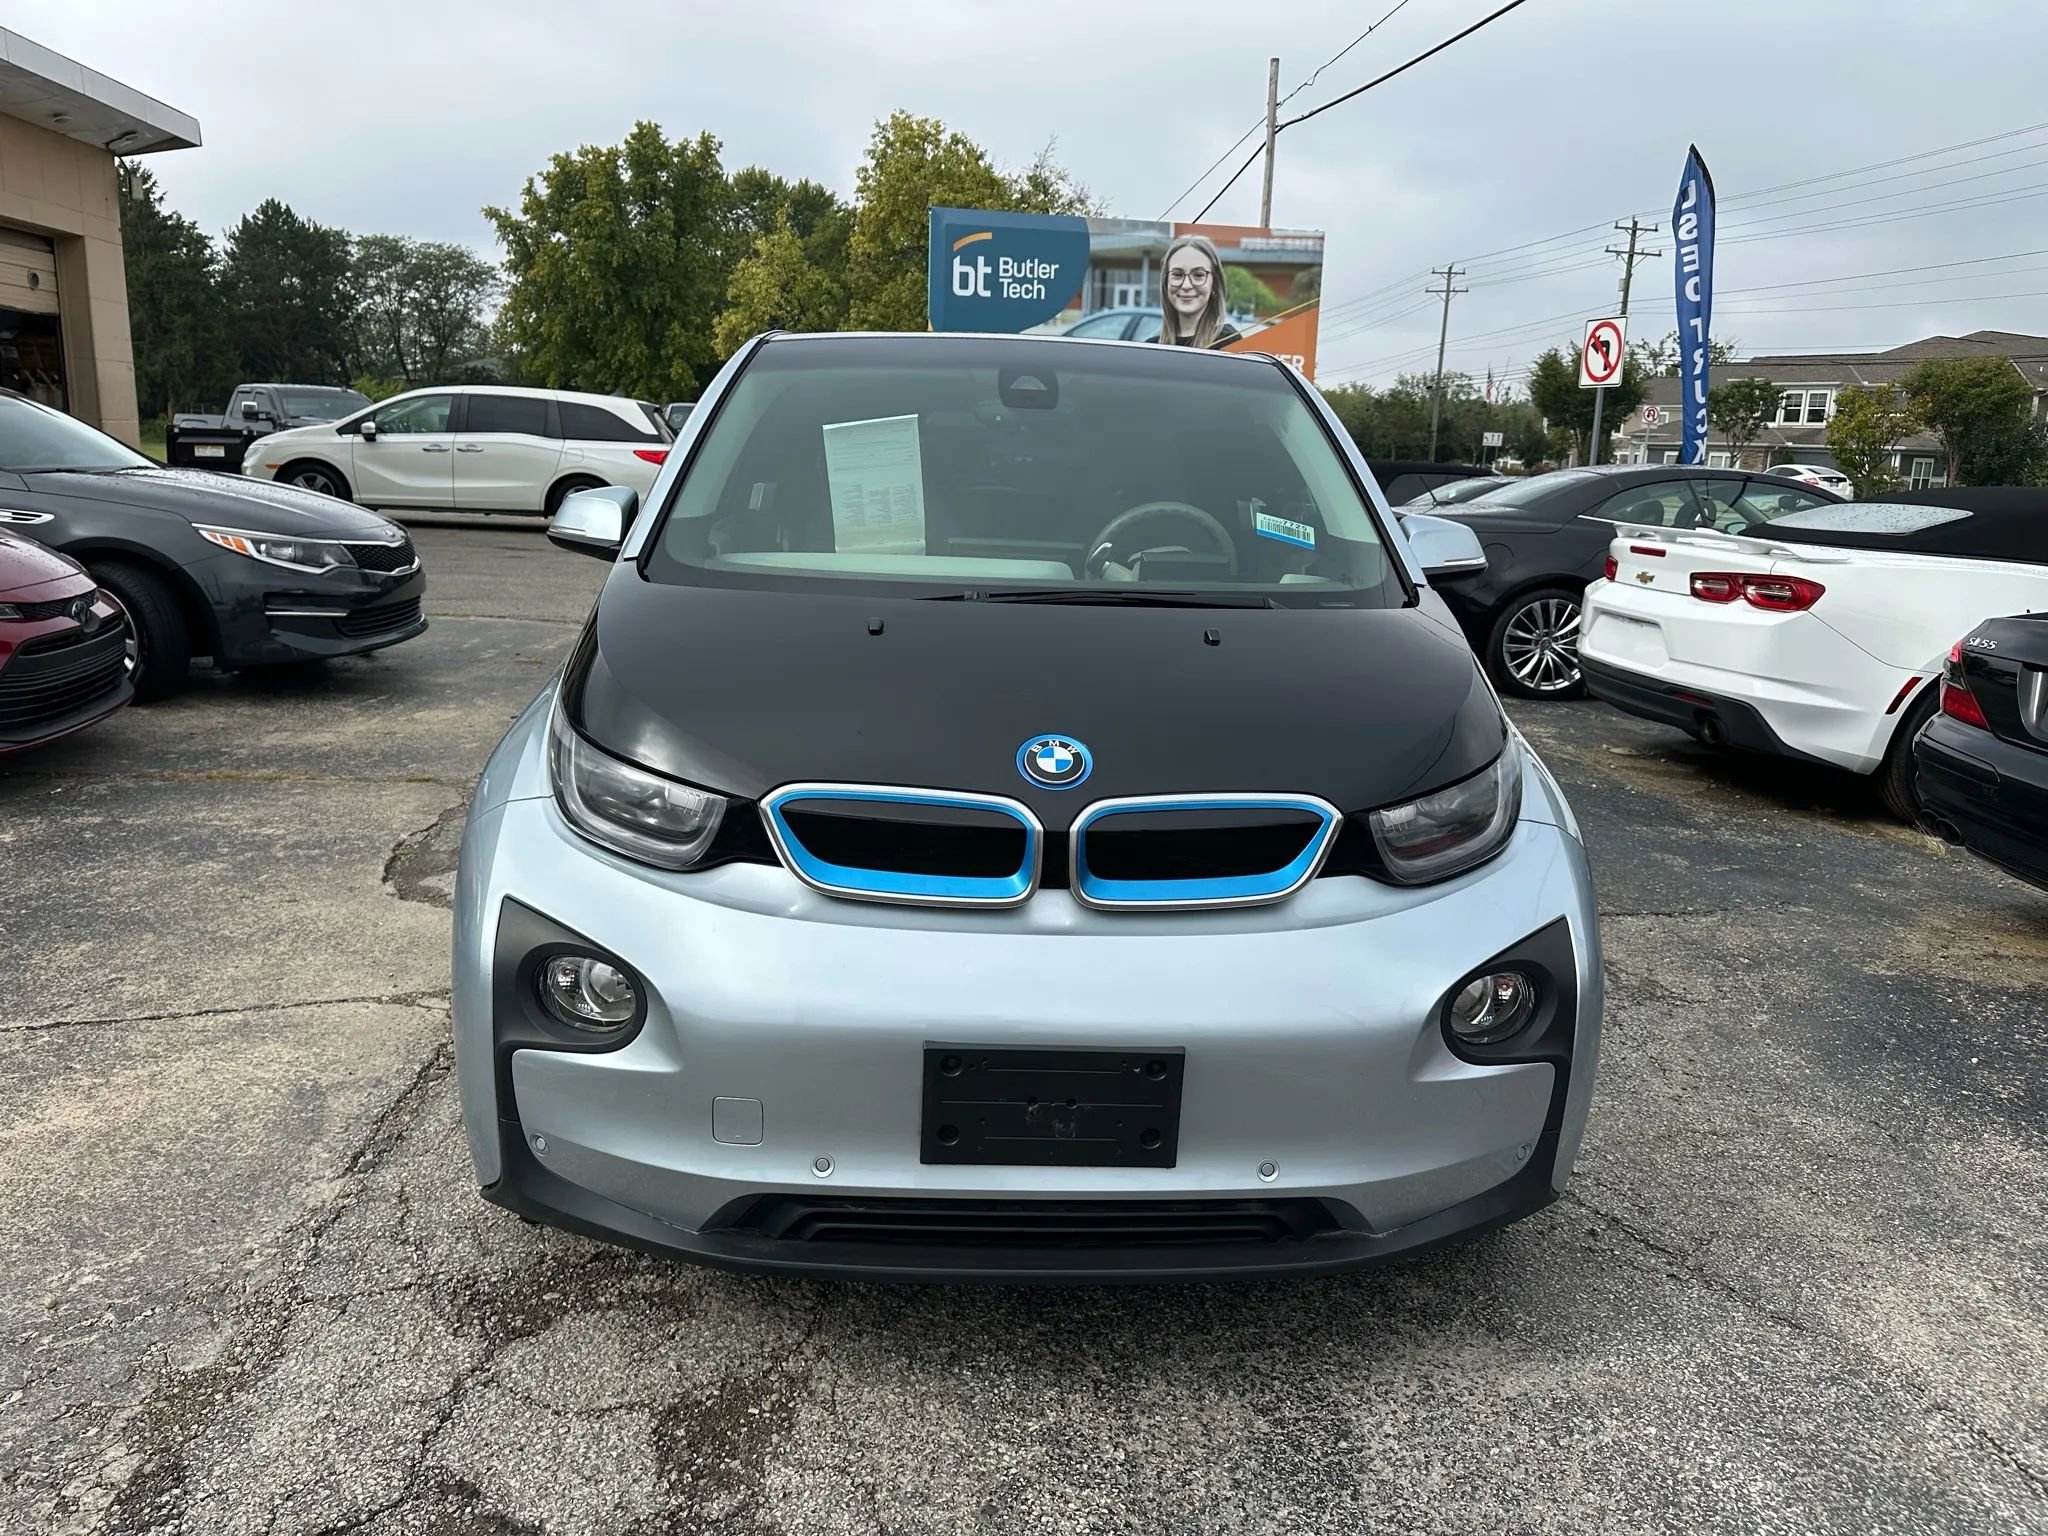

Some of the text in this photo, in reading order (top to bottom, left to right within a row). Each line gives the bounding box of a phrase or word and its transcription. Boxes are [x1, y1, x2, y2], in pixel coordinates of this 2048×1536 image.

[952, 255, 992, 298] bt
[999, 256, 1060, 279] Butler
[999, 278, 1046, 300] Tech
[1030, 740, 1079, 754] BMW
